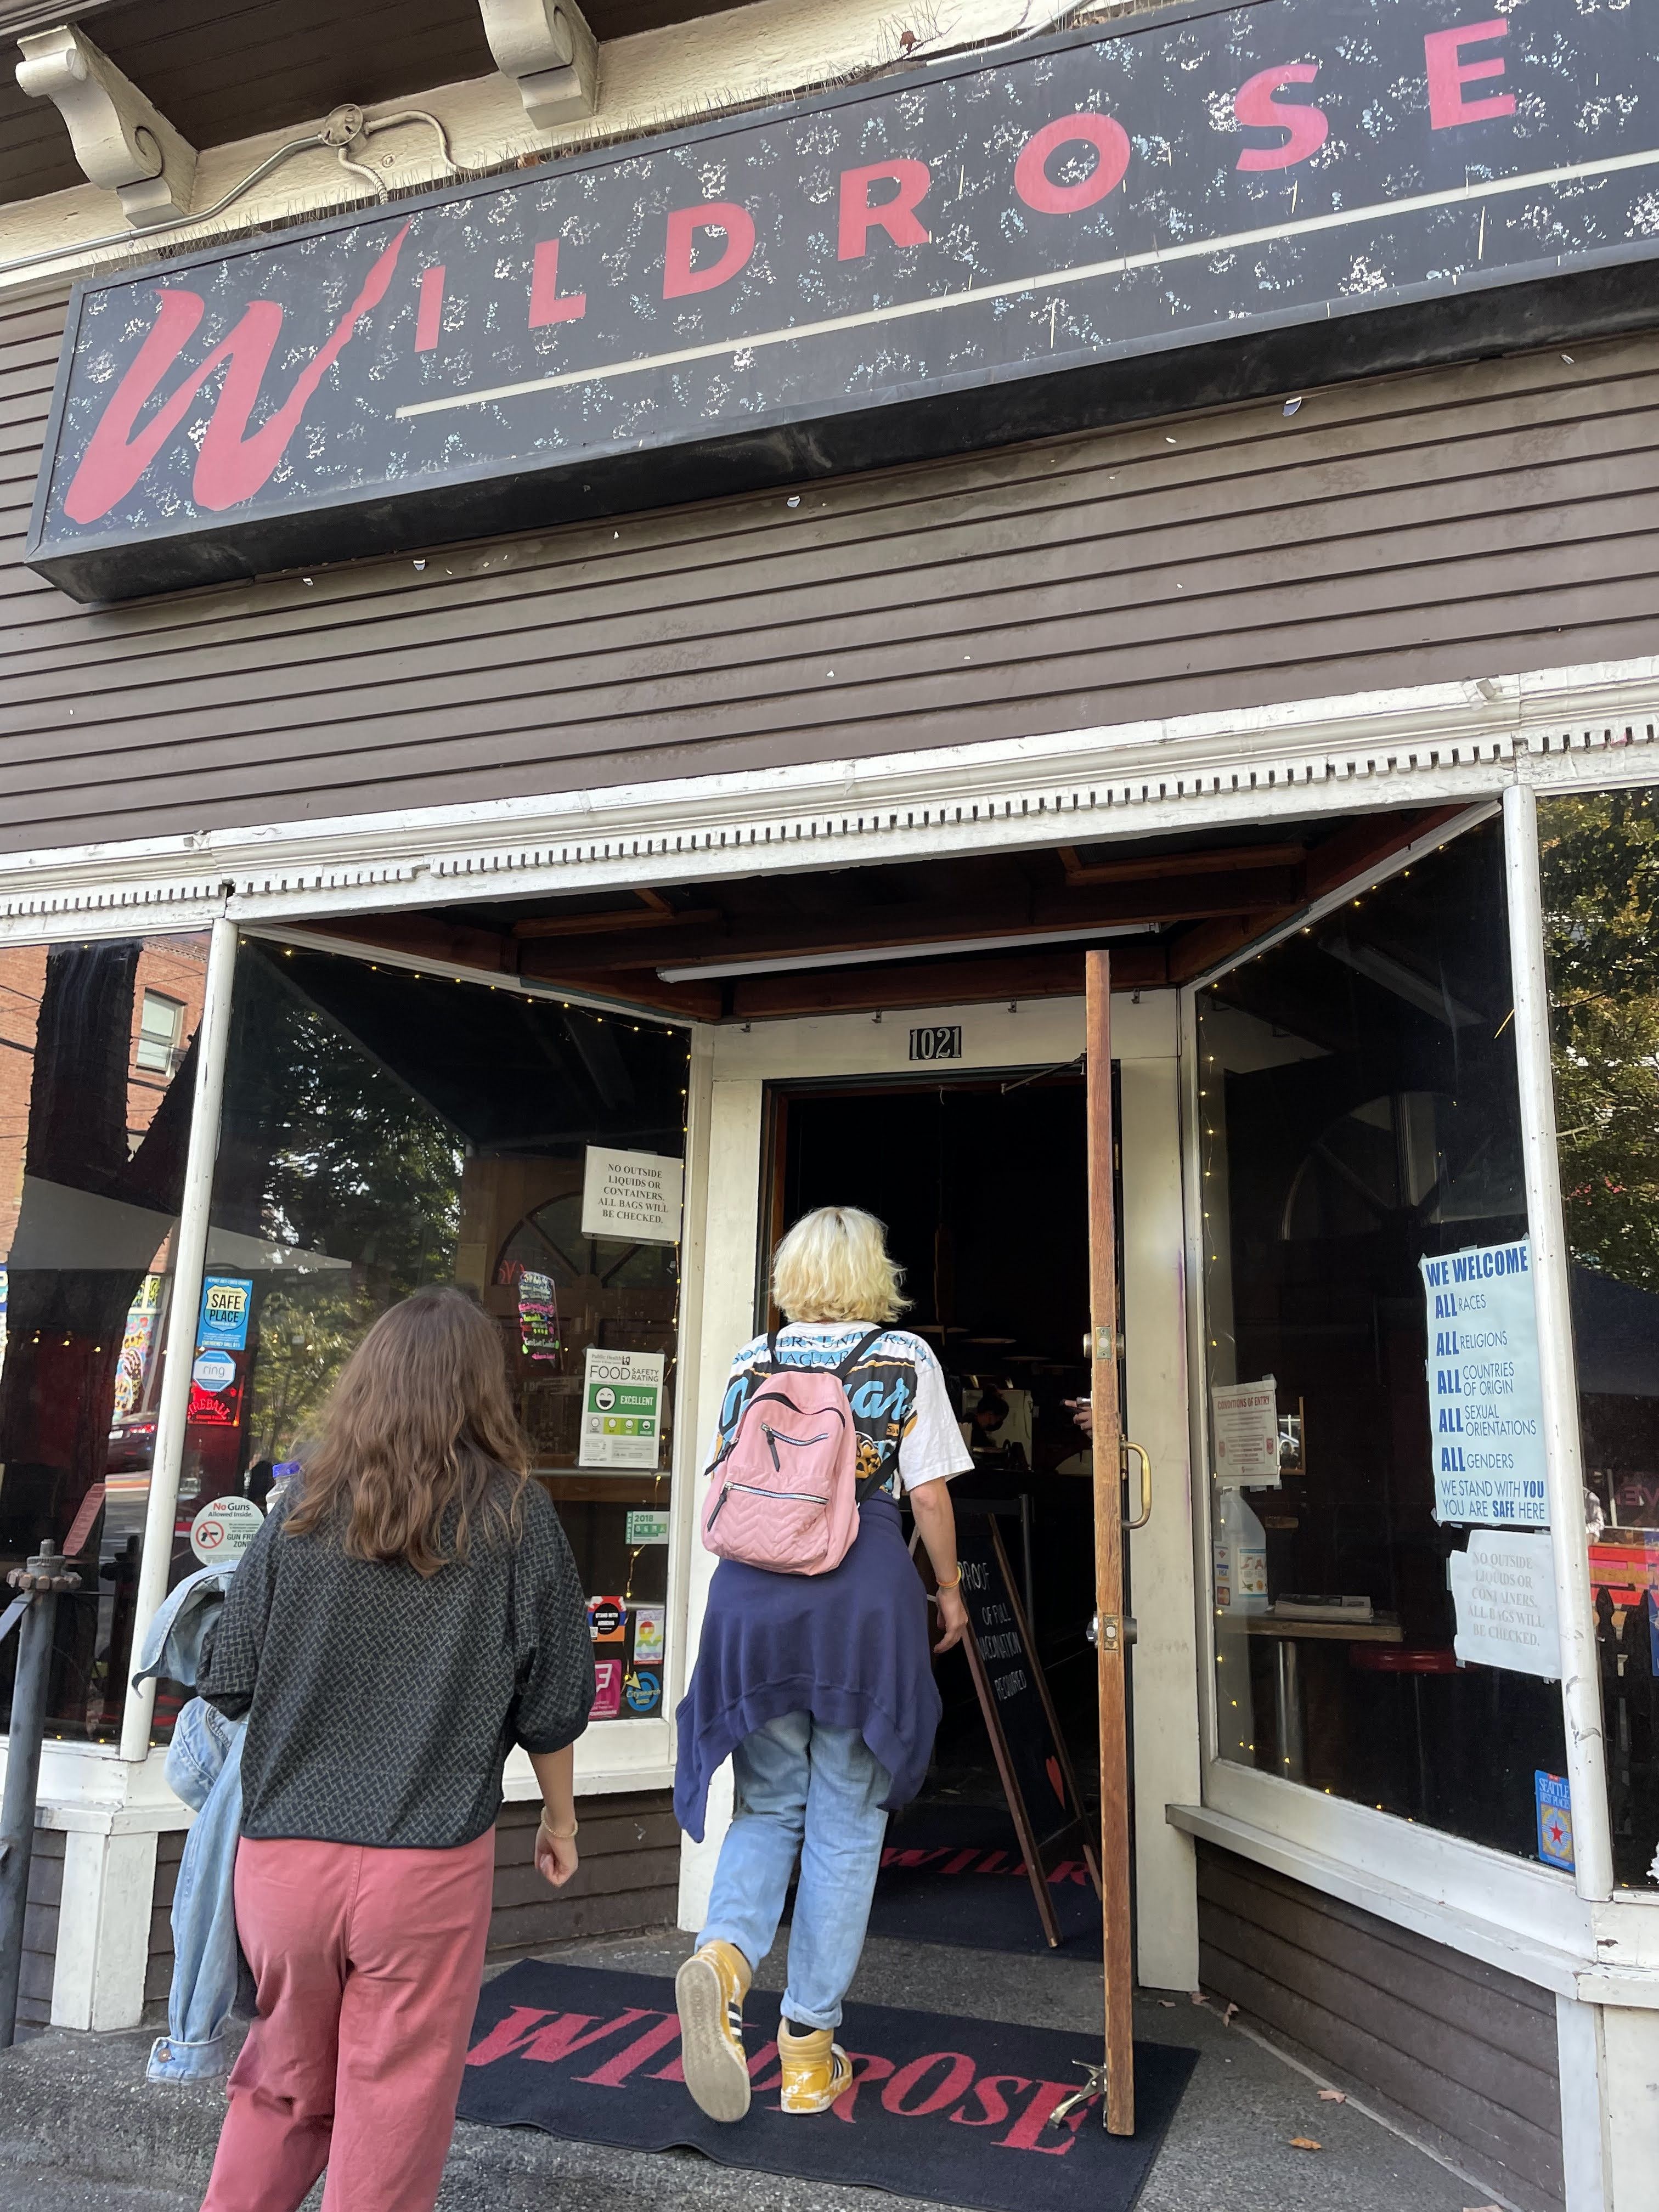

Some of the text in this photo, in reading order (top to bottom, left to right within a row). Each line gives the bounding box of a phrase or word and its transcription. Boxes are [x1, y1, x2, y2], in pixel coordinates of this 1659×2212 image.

[64, 18, 1516, 525] WILDROSE
[911, 1027, 961, 1059] 1021
[608, 1164, 663, 1178] NO OUTSIDE
[608, 1175, 661, 1189] LIQUIDS OR
[603, 1187, 665, 1201] CONTAINERS.
[598, 1198, 669, 1213] ALL BAGS WILL
[602, 1209, 663, 1223] BE CHECKED.
[1426, 1246, 1528, 1287] WE WELCOME
[211, 1294, 241, 1310] SAFE
[1436, 1293, 1486, 1319] ALL RACES
[210, 1310, 240, 1323] PLACE
[1436, 1331, 1508, 1356] ALL RELIGIONS
[203, 1365, 225, 1378] ring
[590, 1365, 630, 1380] FOOD
[1437, 1362, 1514, 1395] ALL COUNTRIES
[1463, 1379, 1513, 1396] OF ORIGIN
[188, 1398, 230, 1420] IREBALL
[620, 1395, 654, 1406] EXCELLENT
[1217, 1396, 1270, 1410] CONDITIONS OF ENTRY
[1439, 1404, 1499, 1432] ALL SEXUAL
[1466, 1420, 1536, 1436] ORIENTATIONS
[1441, 1447, 1514, 1471] ALL GENDERS
[1441, 1480, 1544, 1499] WE STAND WITH YOU
[1442, 1499, 1545, 1519] YOU ARE SAFE HERE
[1474, 1552, 1533, 1570] NO OUTSIDE
[957, 1561, 990, 1591] PROOF
[1475, 1570, 1533, 1589] LIQUIDS OR
[1468, 1604, 1545, 1628] ALL BAGS WILL
[1474, 1623, 1540, 1646] BE CHECKED.
[1539, 1778, 1570, 1799] SEATTLE
